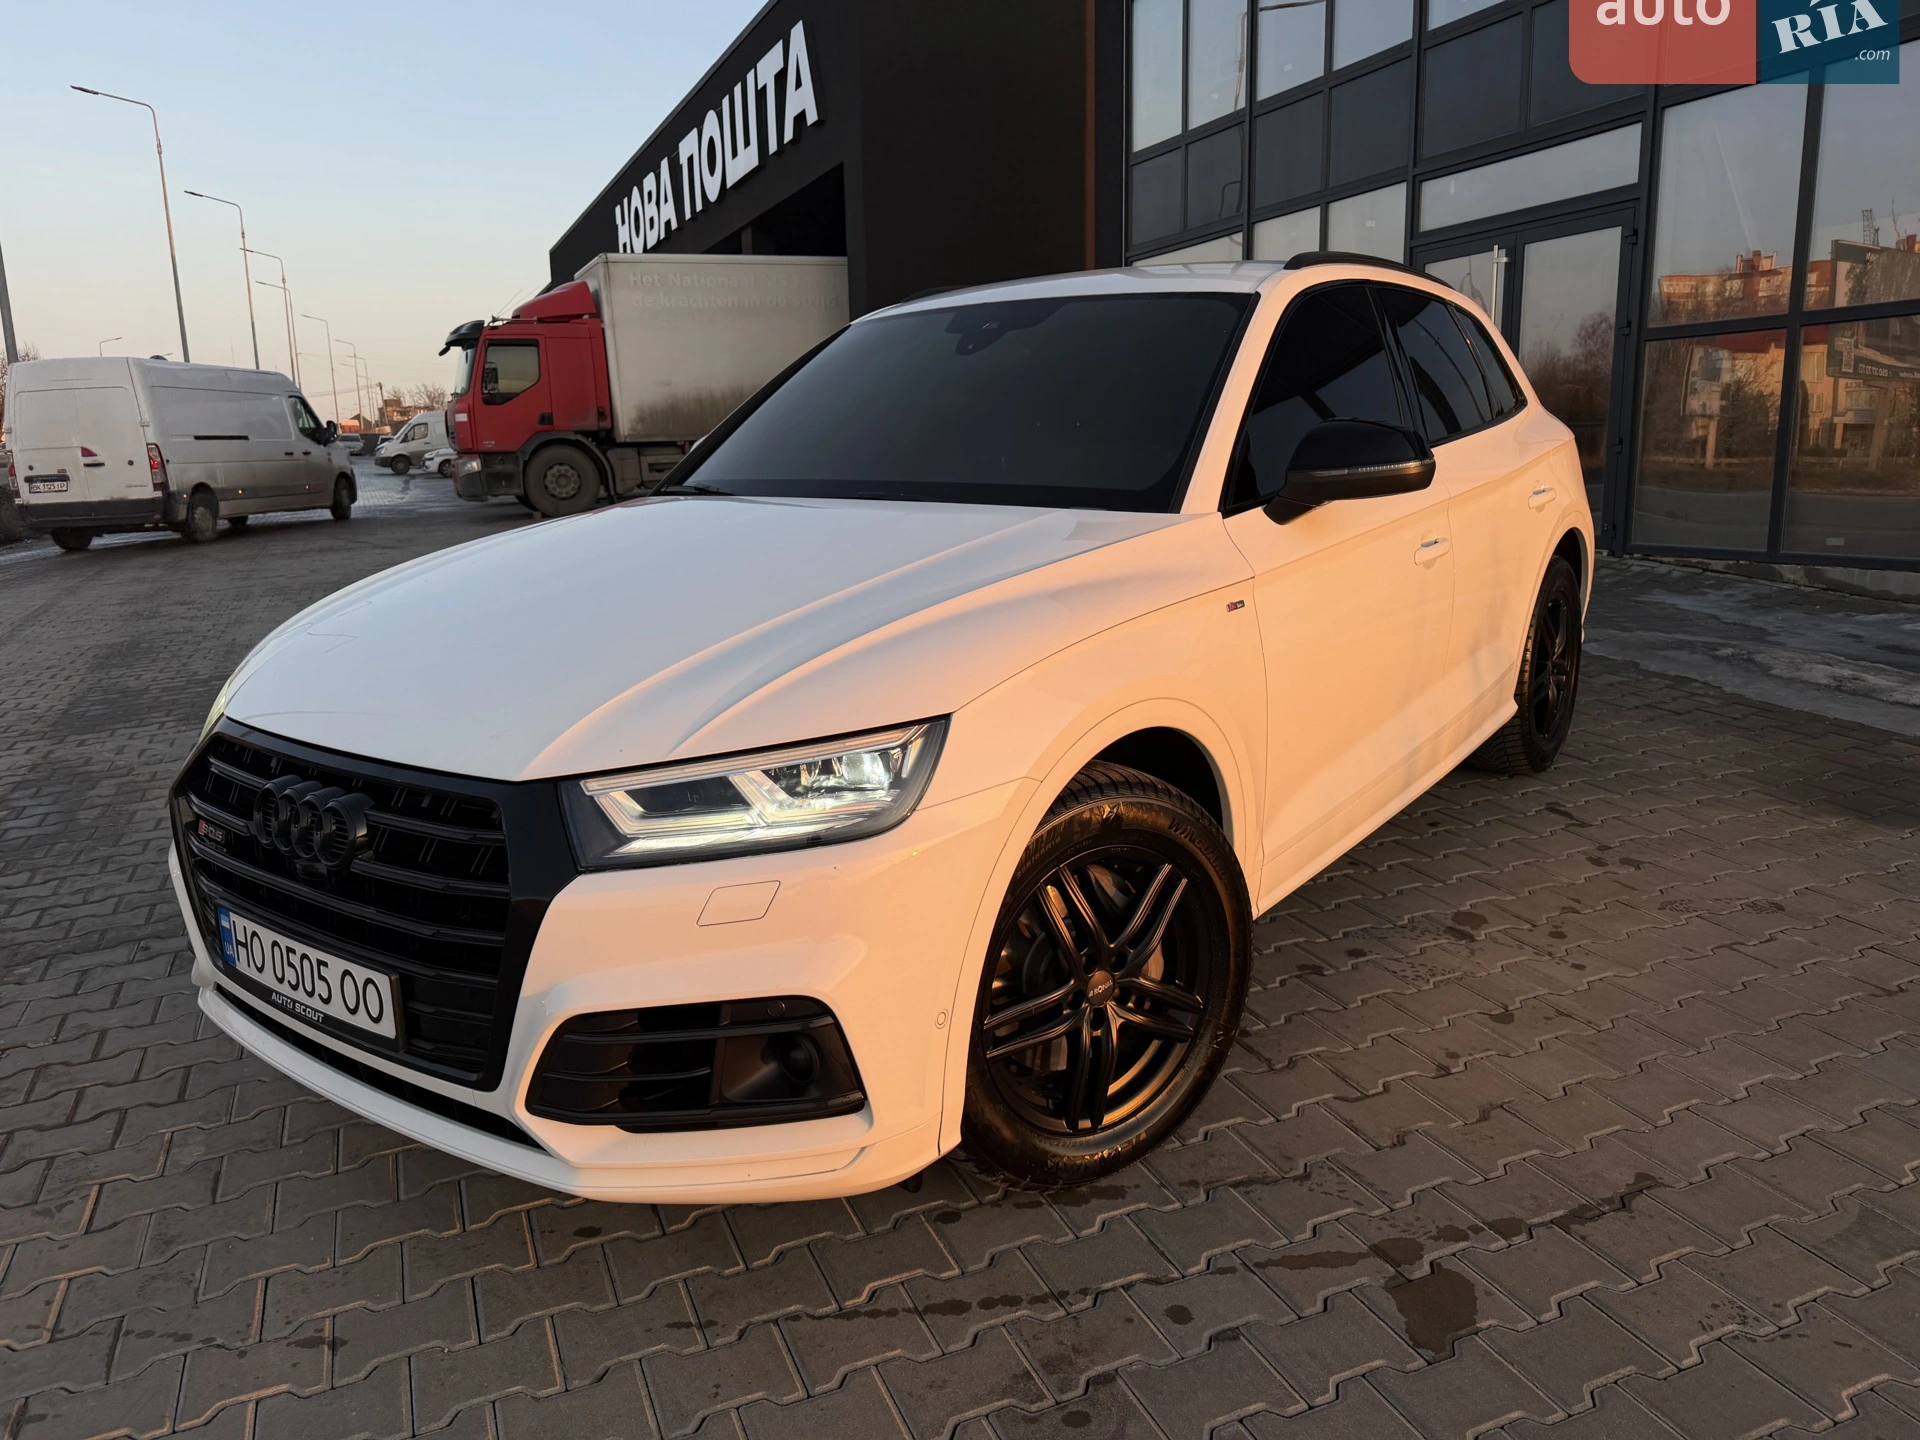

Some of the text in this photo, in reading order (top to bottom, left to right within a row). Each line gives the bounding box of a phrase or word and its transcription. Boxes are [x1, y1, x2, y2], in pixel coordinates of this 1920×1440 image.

[615, 19, 819, 253] НОВА ПОШТА
[224, 941, 235, 958] UA
[232, 919, 384, 1024] HO 0505 OO
[271, 991, 325, 1023] AUTO SCOUT
